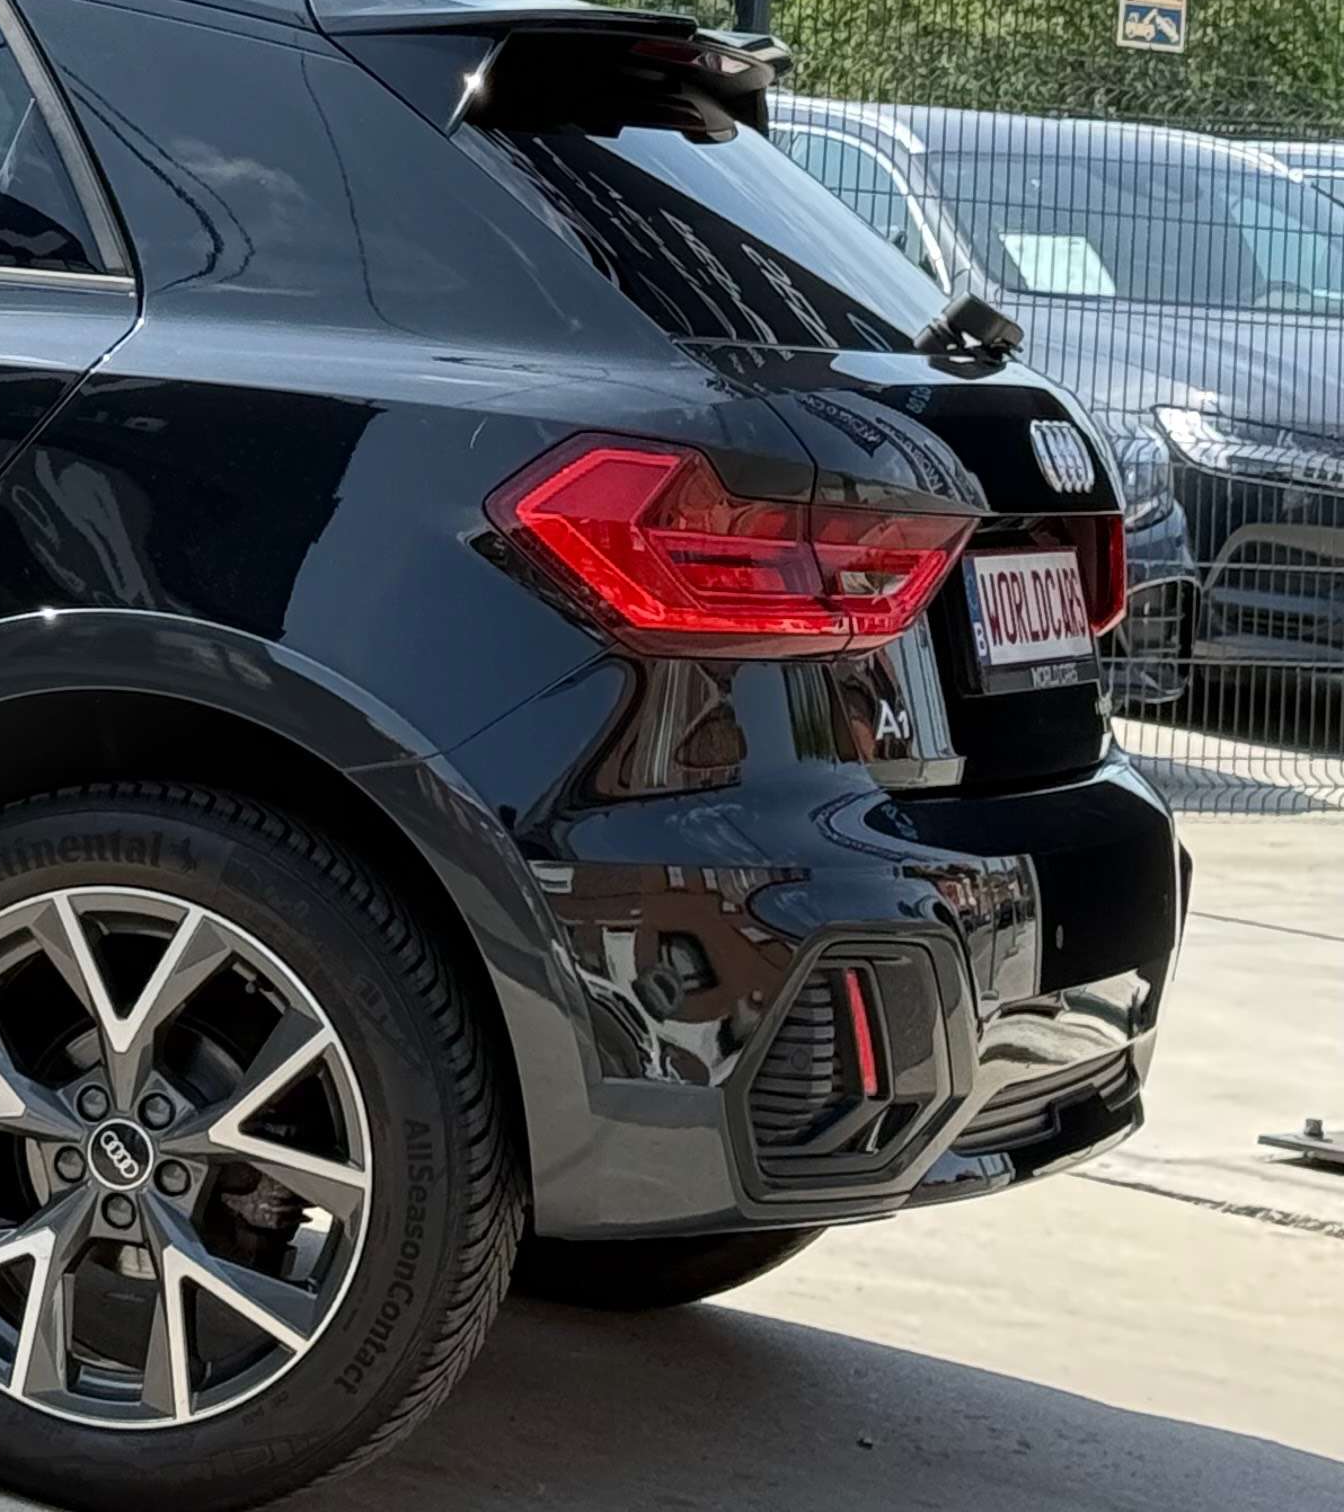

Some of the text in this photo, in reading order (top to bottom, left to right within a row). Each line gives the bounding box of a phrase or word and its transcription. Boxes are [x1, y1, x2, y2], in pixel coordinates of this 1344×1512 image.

[979, 567, 1086, 647] WORLDCARS
[973, 622, 988, 657] B
[875, 699, 911, 741] A1
[334, 1118, 432, 1396] AllSeasonContact
